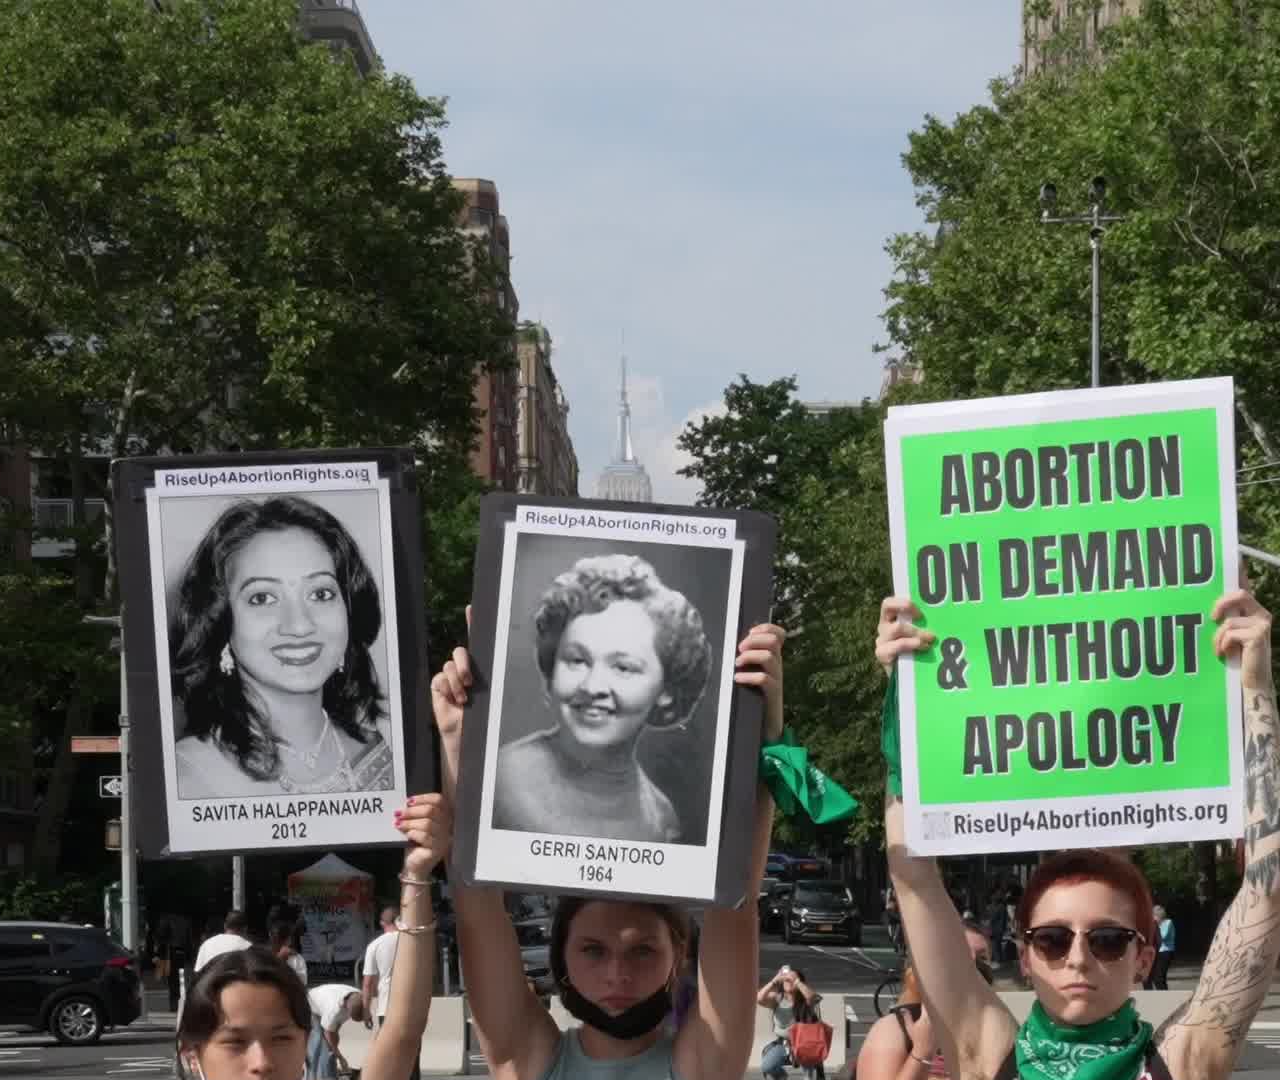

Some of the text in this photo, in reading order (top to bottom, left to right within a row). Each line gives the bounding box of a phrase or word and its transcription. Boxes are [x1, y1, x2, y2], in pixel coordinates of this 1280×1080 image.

[940, 433, 1183, 517] ABORTION
[526, 511, 727, 539] RiseUp4AbortionRights.org
[917, 522, 1216, 606] ON DEMAND
[936, 613, 1203, 691] & WITHOUT
[963, 702, 1184, 776] APOLOGY
[192, 798, 384, 822] SAVITA HALAPPANAVAR
[954, 803, 1228, 836] RiseUp4AbortionRights.org
[271, 822, 307, 839] 2012
[530, 839, 665, 866] GERRI SANTORO
[579, 865, 613, 882] 1964
